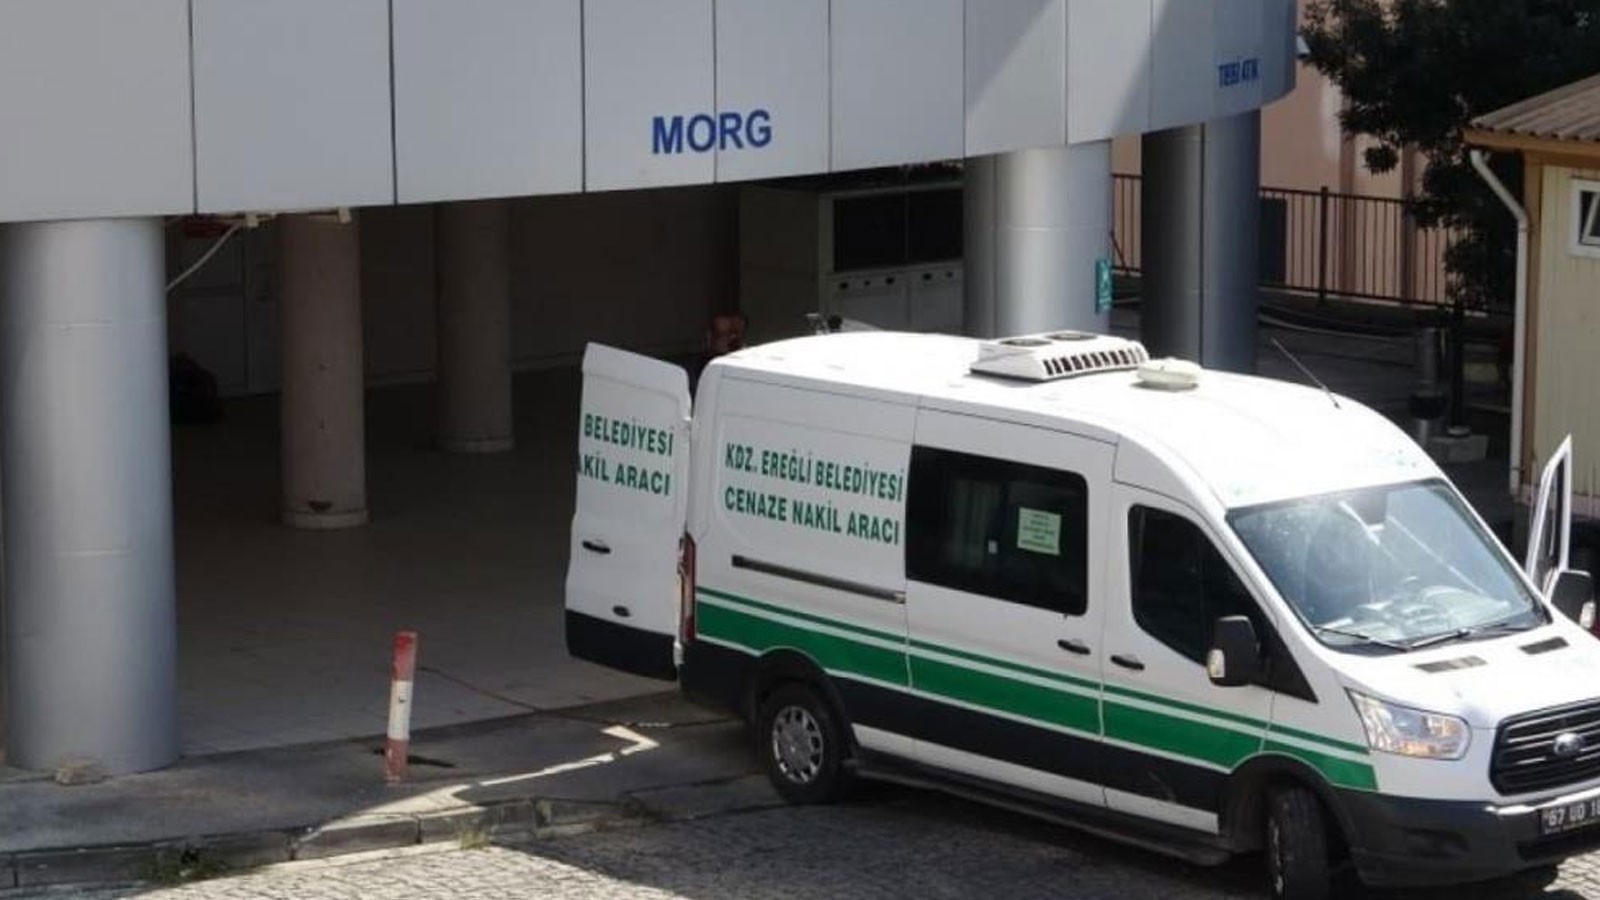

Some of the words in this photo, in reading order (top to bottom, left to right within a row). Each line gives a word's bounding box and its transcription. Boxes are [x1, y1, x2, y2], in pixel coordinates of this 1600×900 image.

[652, 109, 772, 154] MORG
[583, 413, 674, 456] BELEDİYESİ
[579, 447, 610, 482] KİL
[614, 463, 671, 496] ARACI
[725, 441, 758, 473] KDZ.
[761, 448, 812, 484] EREĞLİ
[814, 459, 904, 502] BELEDİYESİ
[724, 485, 787, 522] CENAZE
[791, 500, 842, 534] NAKİL
[846, 510, 899, 545] ARACI
[1549, 808, 1564, 827] 67
